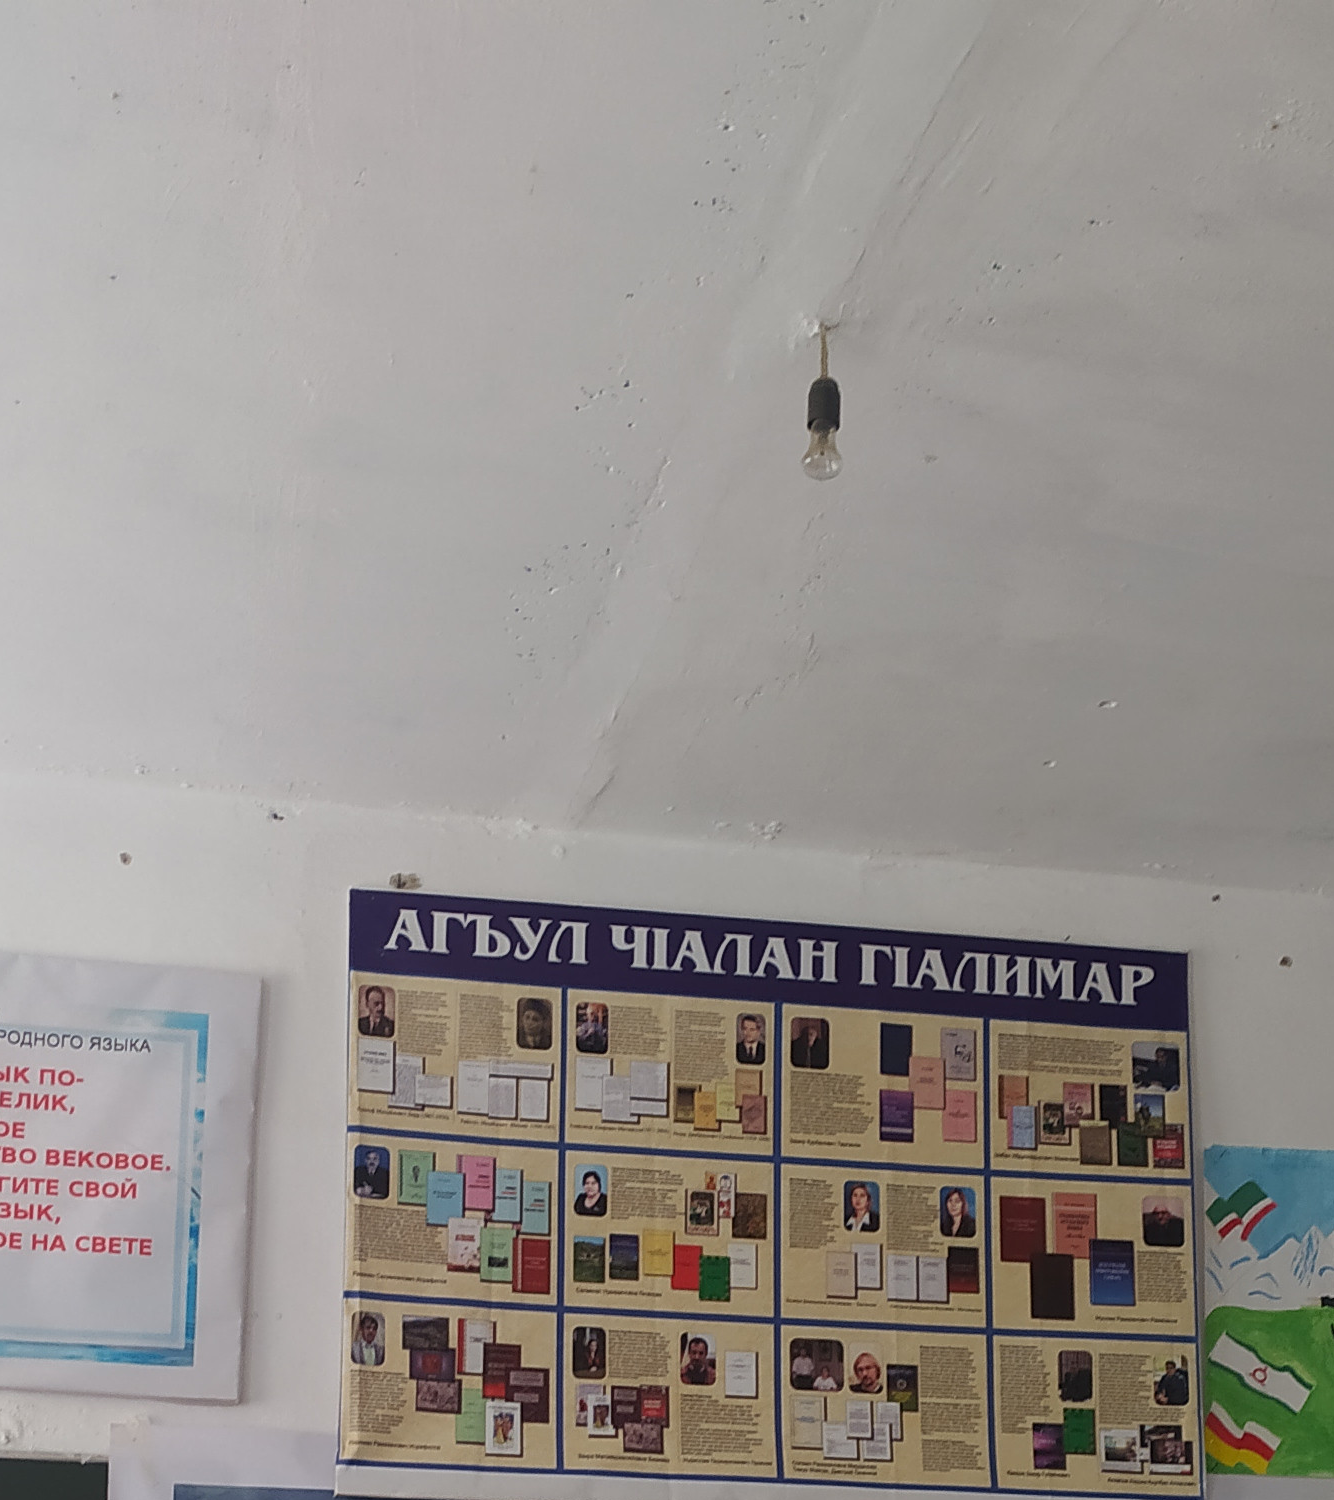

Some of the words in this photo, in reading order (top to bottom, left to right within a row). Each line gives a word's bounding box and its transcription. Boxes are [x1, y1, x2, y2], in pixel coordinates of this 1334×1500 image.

[383, 906, 589, 965] АГЪУЛ
[88, 1037, 151, 1053] ЯЗЫКА
[39, 1069, 84, 1087] ПО-
[45, 1149, 170, 1171] ВЕКОВОЕ.
[69, 1178, 137, 1199] СВОЙ
[31, 1234, 66, 1252] НА
[75, 1236, 152, 1256] СВЕТЕ
